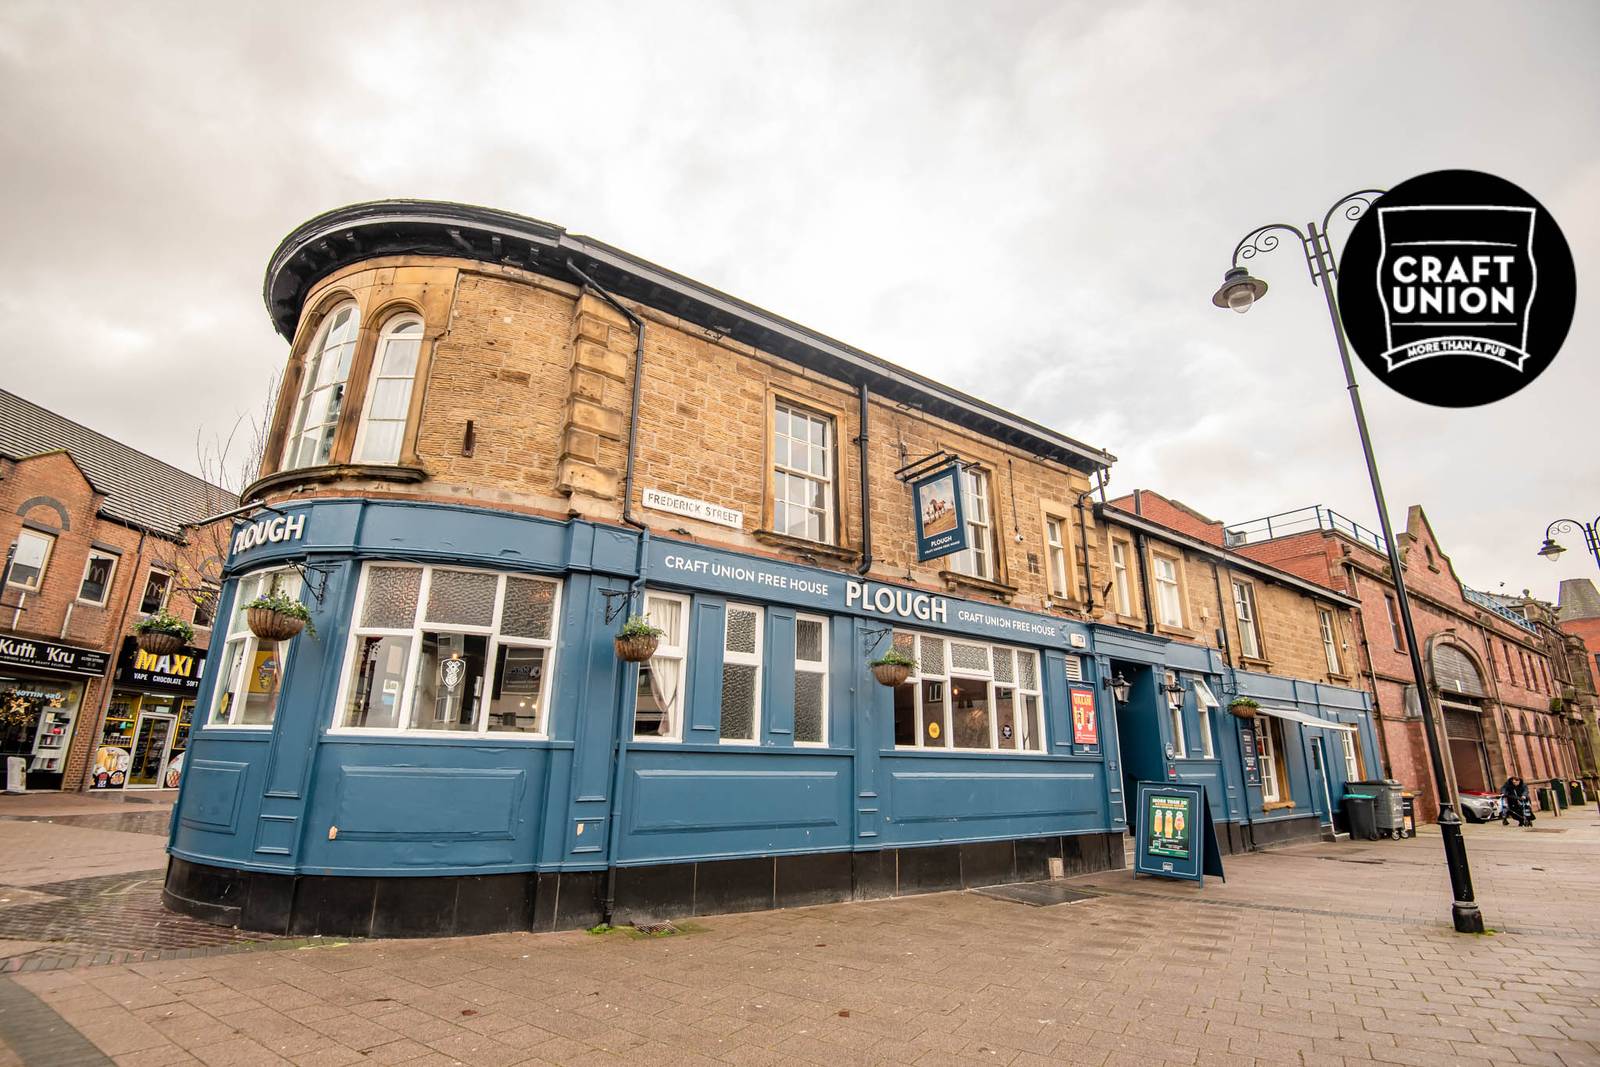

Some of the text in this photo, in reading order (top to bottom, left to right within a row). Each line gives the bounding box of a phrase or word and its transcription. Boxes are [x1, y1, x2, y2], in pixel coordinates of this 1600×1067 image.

[648, 493, 738, 523] FREDERICK STREET
[232, 514, 305, 555] PLOUGH
[931, 536, 952, 547] PLOUGH
[665, 555, 829, 595] CRAFT UNION FREE HOUSE
[845, 580, 947, 623] PLOUGH
[958, 610, 1056, 637] CRAFT UNION FREE HOUSE
[134, 648, 193, 677] MAXI
[134, 672, 199, 688] VAPE CHOCOLATE SOFT
